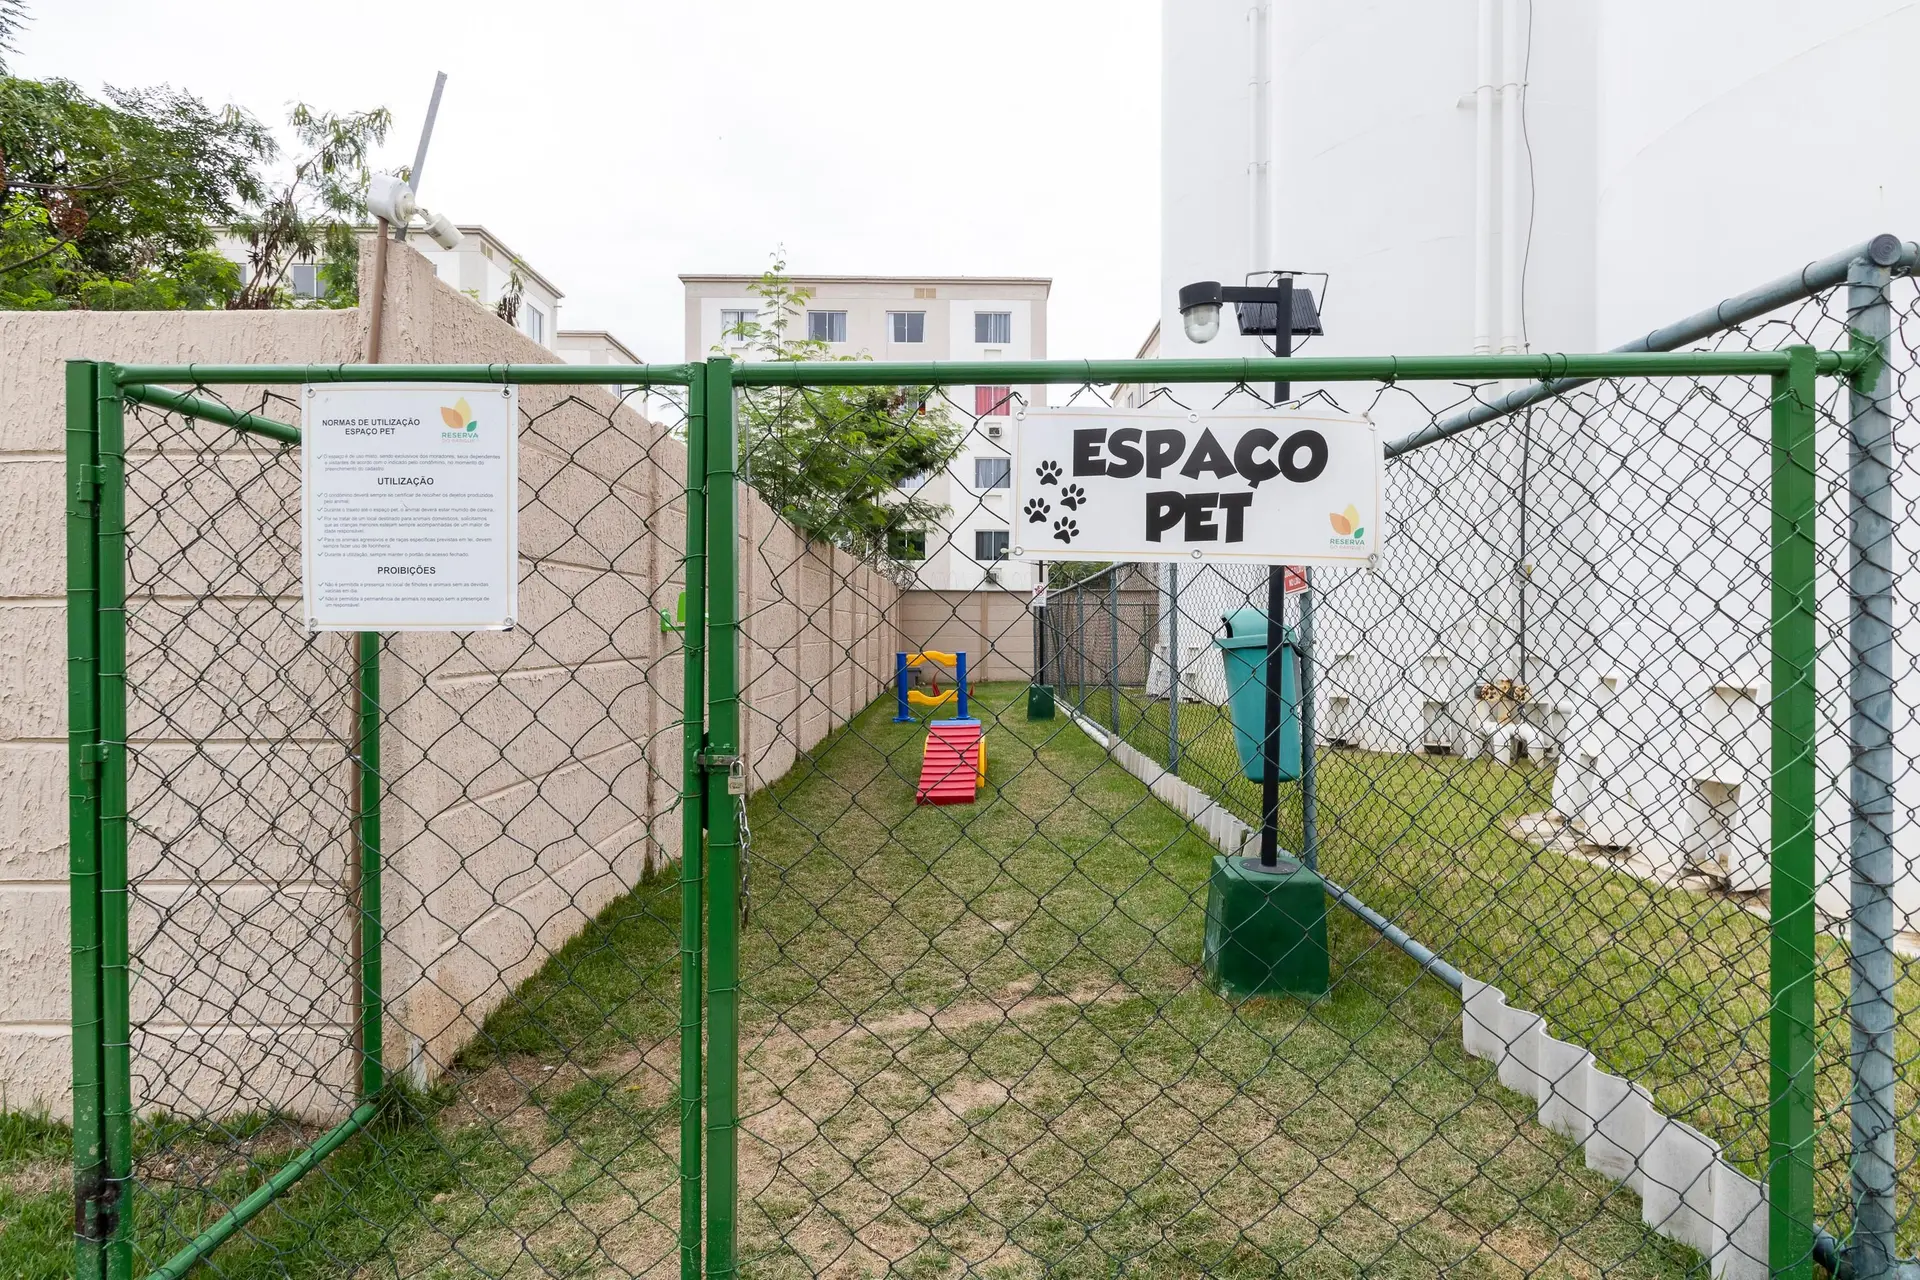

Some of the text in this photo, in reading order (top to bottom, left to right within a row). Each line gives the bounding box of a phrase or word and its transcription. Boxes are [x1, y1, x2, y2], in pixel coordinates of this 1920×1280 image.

[322, 418, 420, 426] NORMAS DE UTILIZAÇÃO
[345, 427, 395, 436] ESPAÇO PET
[1073, 427, 1328, 490] ESPAÇO
[377, 476, 434, 486] UTILIZAÇÃO
[1146, 490, 1254, 543] PET
[377, 565, 436, 576] PROIBIÇÕES
